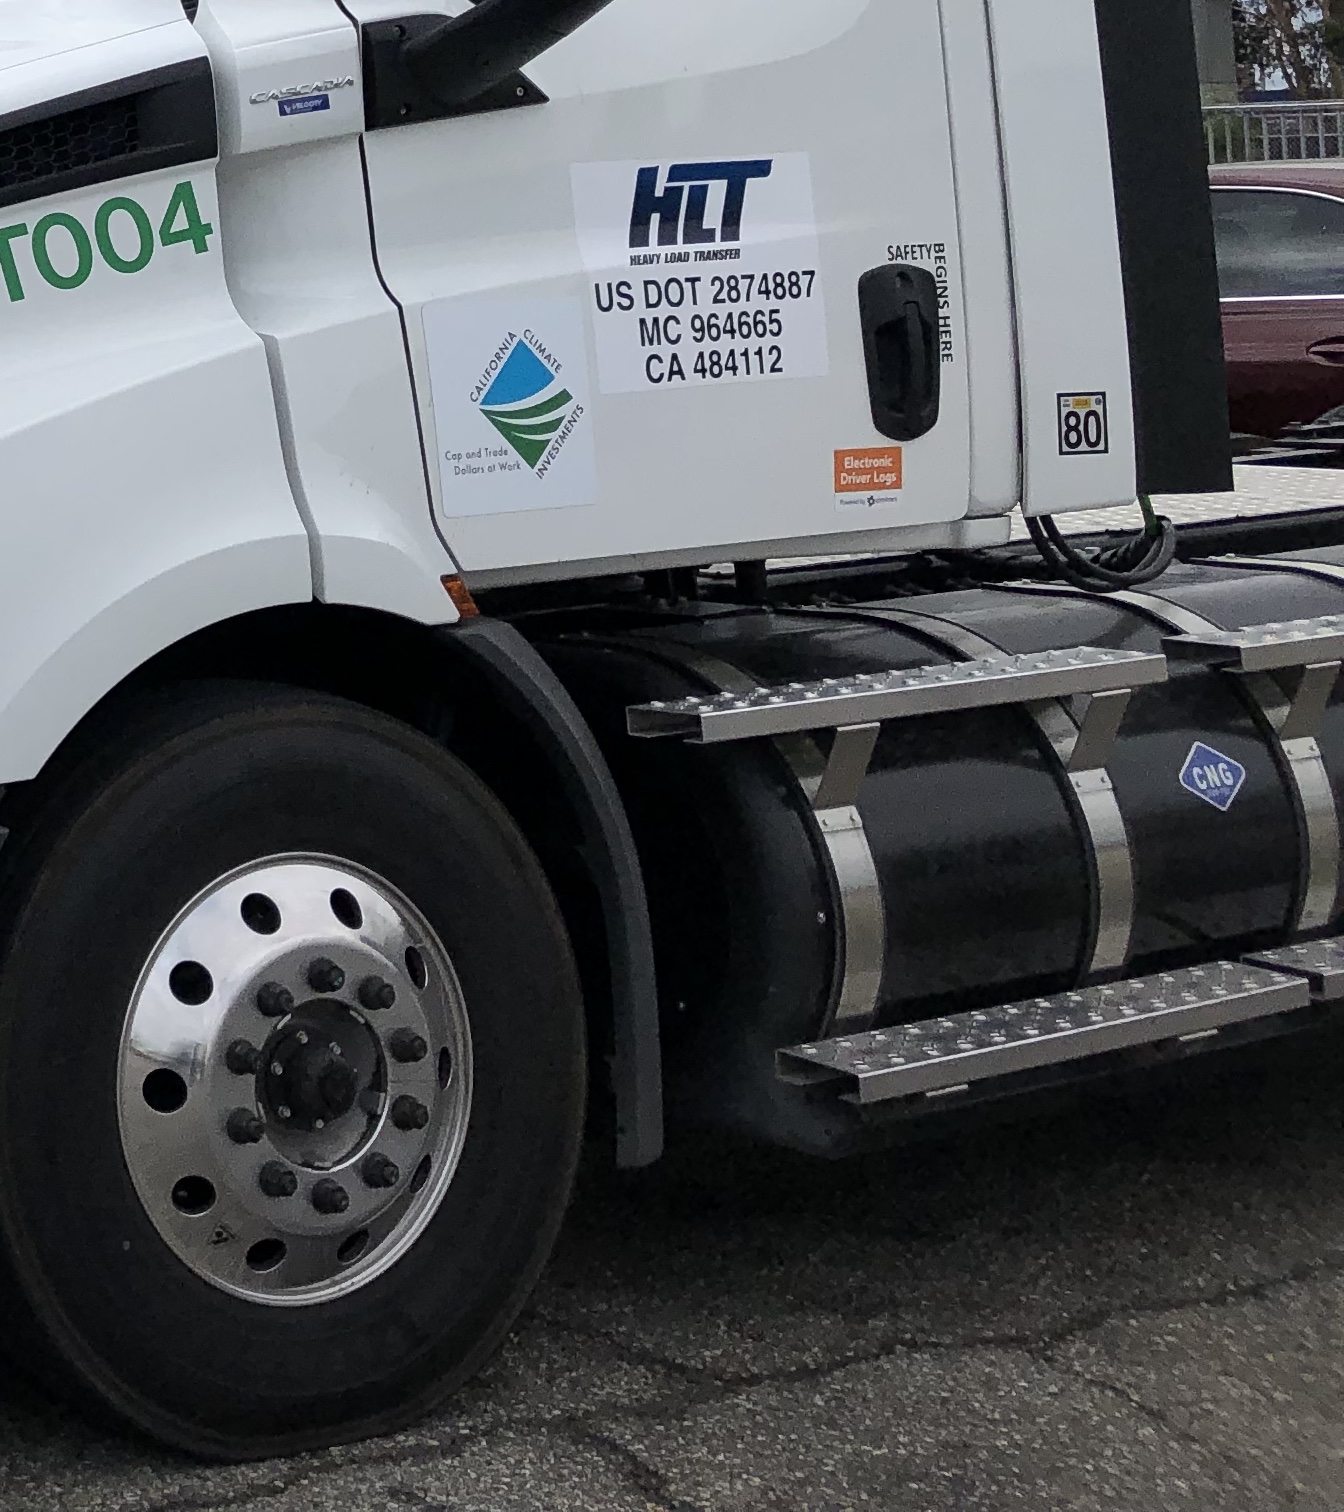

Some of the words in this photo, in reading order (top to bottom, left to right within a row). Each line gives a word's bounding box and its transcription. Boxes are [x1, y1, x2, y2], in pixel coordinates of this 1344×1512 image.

[629, 159, 773, 248] HLT
[630, 252, 661, 266] HEAVY
[664, 251, 690, 263] LOAD
[693, 248, 741, 262] TRANSFER
[887, 244, 932, 261] SAFETY
[594, 280, 635, 313] US
[643, 276, 701, 310] DOT
[711, 270, 816, 305] 2874887
[933, 243, 950, 310] BEGINS
[639, 314, 682, 347] MC
[690, 308, 783, 344] 964665
[939, 315, 953, 363] HERE
[469, 331, 518, 403] CALIFORNIA
[523, 329, 563, 374] CLIMATE
[646, 352, 686, 384] CA
[693, 345, 784, 380] 484112
[535, 403, 585, 480] INVESTMENTS
[1064, 409, 1102, 449] 80
[445, 450, 463, 462] Cap
[465, 448, 482, 459] and
[484, 446, 509, 458] Trade
[453, 464, 485, 476] Dollars
[487, 464, 496, 473] at
[498, 460, 522, 472] Work
[844, 455, 893, 469] Electronic
[840, 472, 871, 485] Driver
[873, 471, 897, 486] Logs
[1192, 762, 1234, 790] CNG
